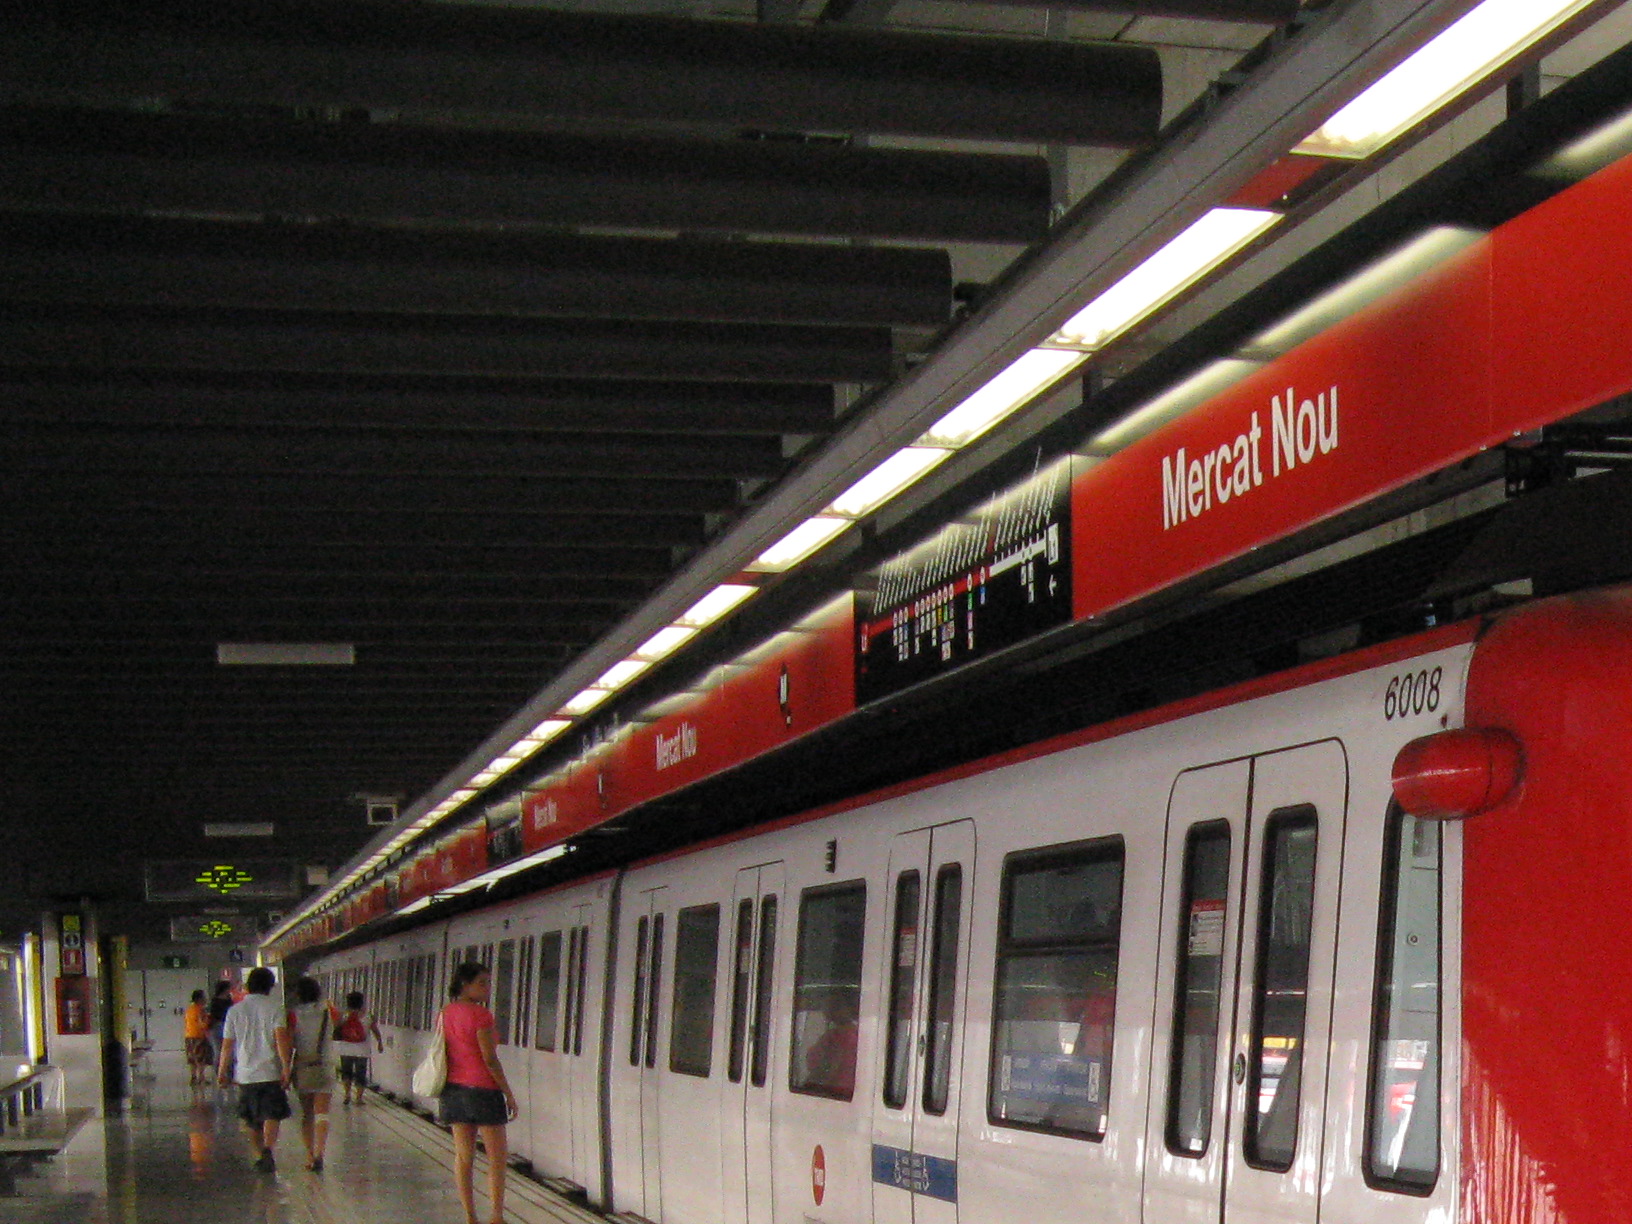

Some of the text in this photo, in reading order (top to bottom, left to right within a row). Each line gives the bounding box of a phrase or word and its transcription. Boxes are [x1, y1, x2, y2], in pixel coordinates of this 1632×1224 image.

[1162, 385, 1338, 530] Mercat Nou
[1384, 665, 1443, 721] 6008
